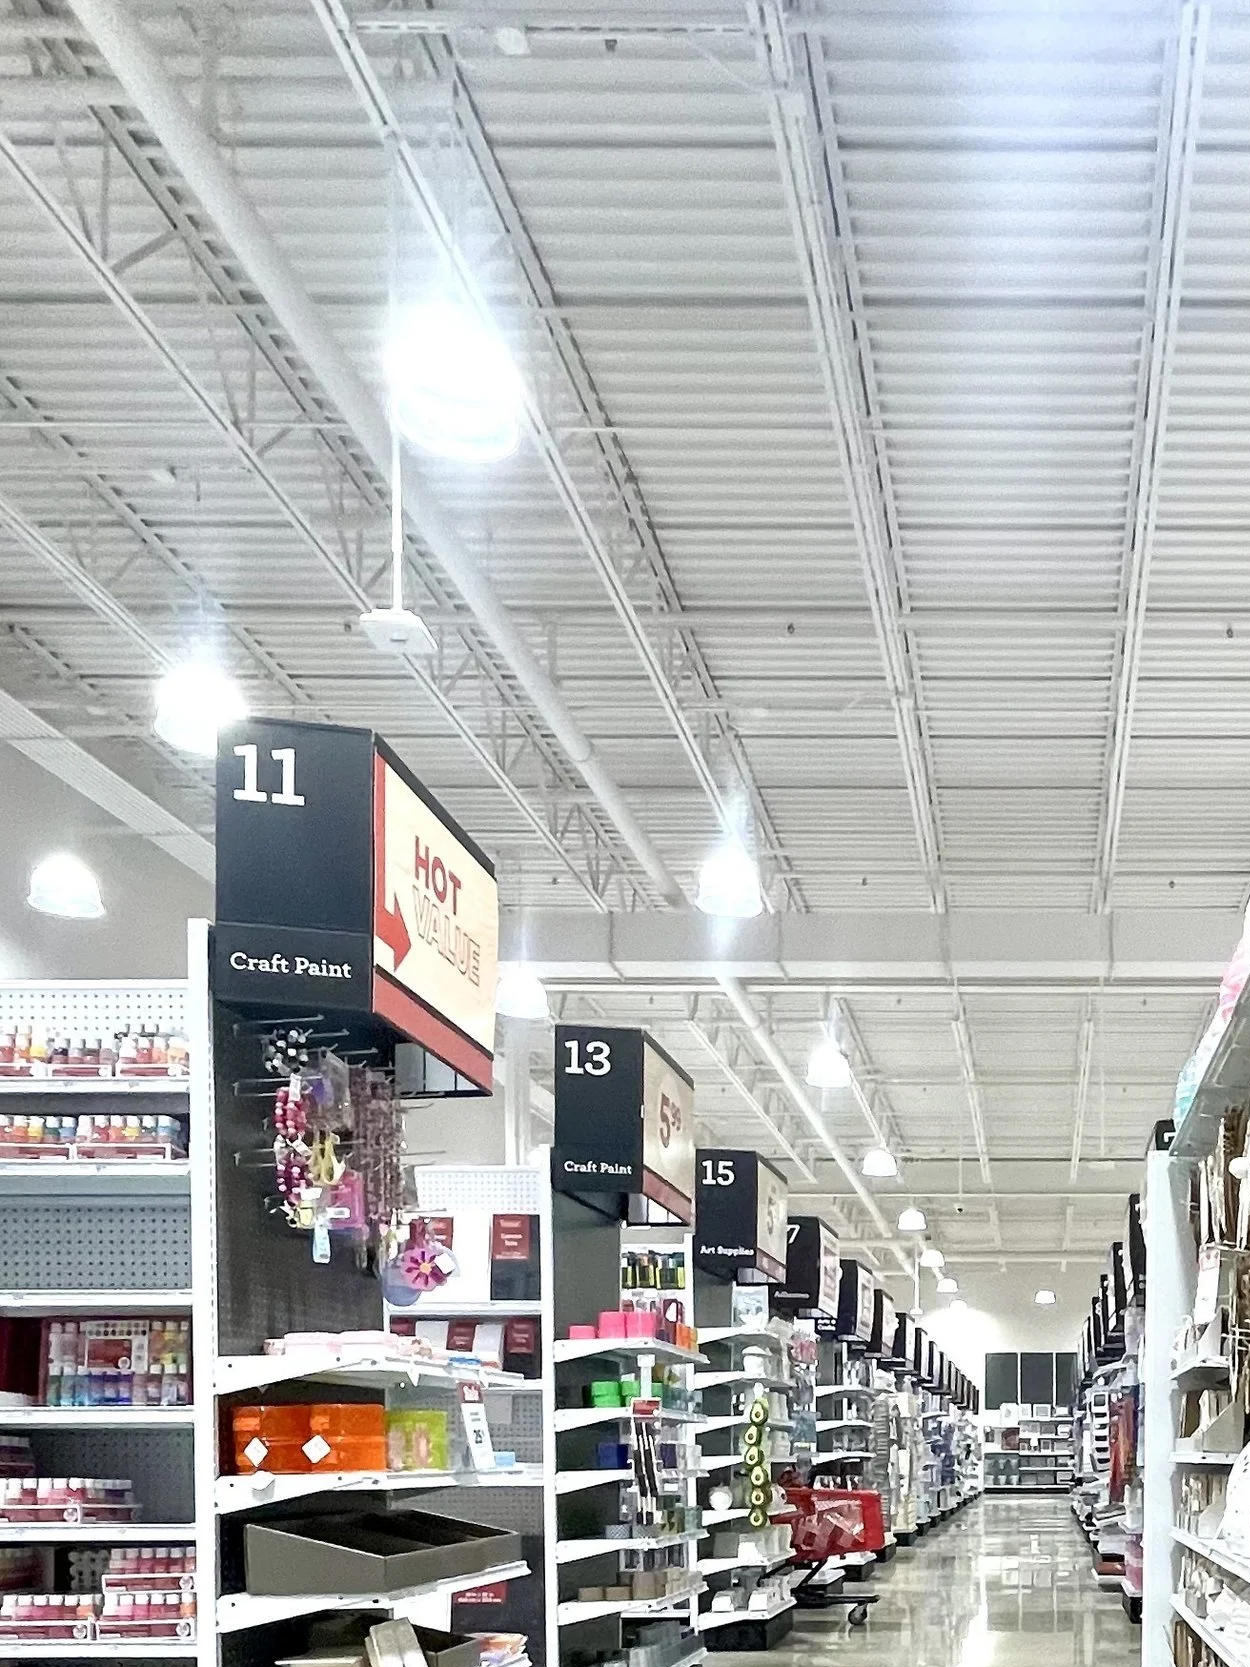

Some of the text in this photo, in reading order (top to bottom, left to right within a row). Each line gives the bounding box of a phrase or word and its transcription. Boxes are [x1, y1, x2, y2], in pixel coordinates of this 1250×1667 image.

[233, 744, 305, 806] 11
[415, 835, 462, 916] HOT
[412, 884, 480, 987] VALUE
[229, 951, 352, 979] Craft Paint
[564, 1040, 612, 1076] 13
[564, 1160, 632, 1175] Craft Paint
[701, 1160, 735, 1186] 15
[787, 1224, 800, 1244] 7
[700, 1245, 716, 1255] Art
